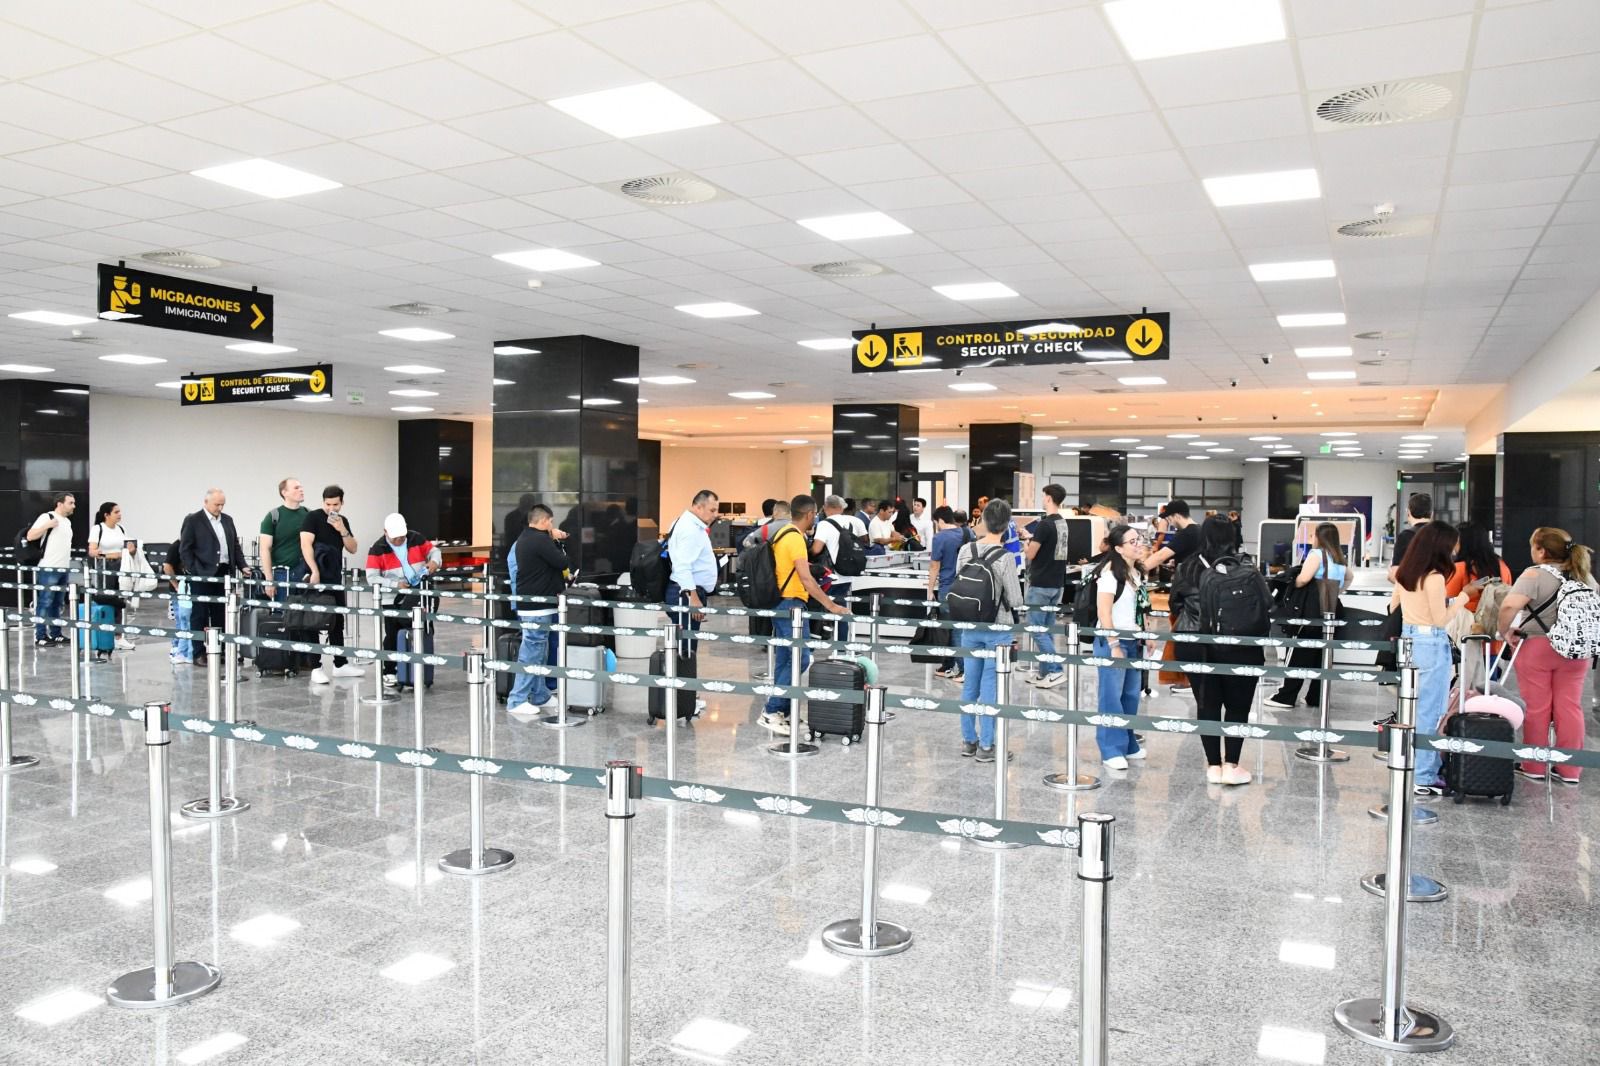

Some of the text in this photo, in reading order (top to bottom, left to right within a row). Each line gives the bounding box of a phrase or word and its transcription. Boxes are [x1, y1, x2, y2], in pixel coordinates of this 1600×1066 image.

[150, 287, 241, 313] MIGRACIONES
[165, 305, 227, 323] IMMIGRATION
[936, 333, 1001, 346] CONTROL
[1005, 331, 1024, 343] DE
[961, 341, 1083, 357] SECURITY CHECK
[220, 379, 252, 387] CONTROL
[252, 377, 262, 385] DE
[232, 384, 290, 395] SECURITY CHECK
